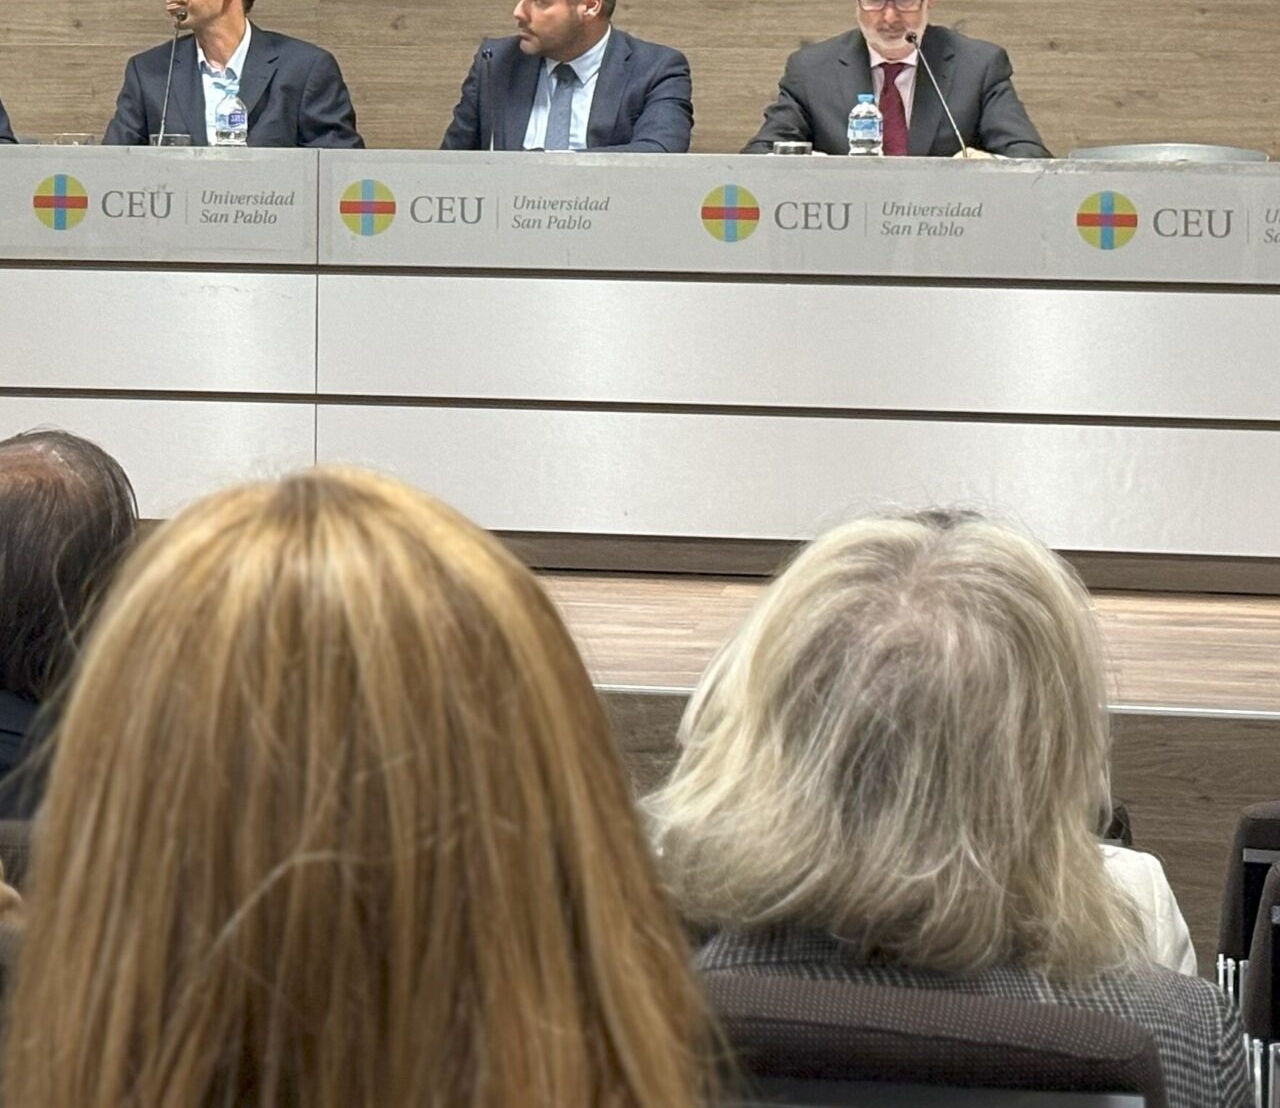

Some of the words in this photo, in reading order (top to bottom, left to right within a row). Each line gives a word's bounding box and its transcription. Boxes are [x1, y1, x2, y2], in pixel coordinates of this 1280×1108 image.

[101, 190, 175, 219] CEU
[201, 190, 295, 206] Universidad
[513, 196, 610, 212] Universidad
[200, 209, 229, 223] San
[233, 209, 277, 224] Pablo
[410, 196, 485, 224] CEU
[774, 201, 853, 231] CEU
[882, 202, 983, 217] Universidad
[512, 214, 542, 229] San
[546, 215, 591, 230] Pablo
[881, 221, 912, 236] San
[917, 221, 964, 237] Pablo
[1153, 208, 1234, 238] CEU
